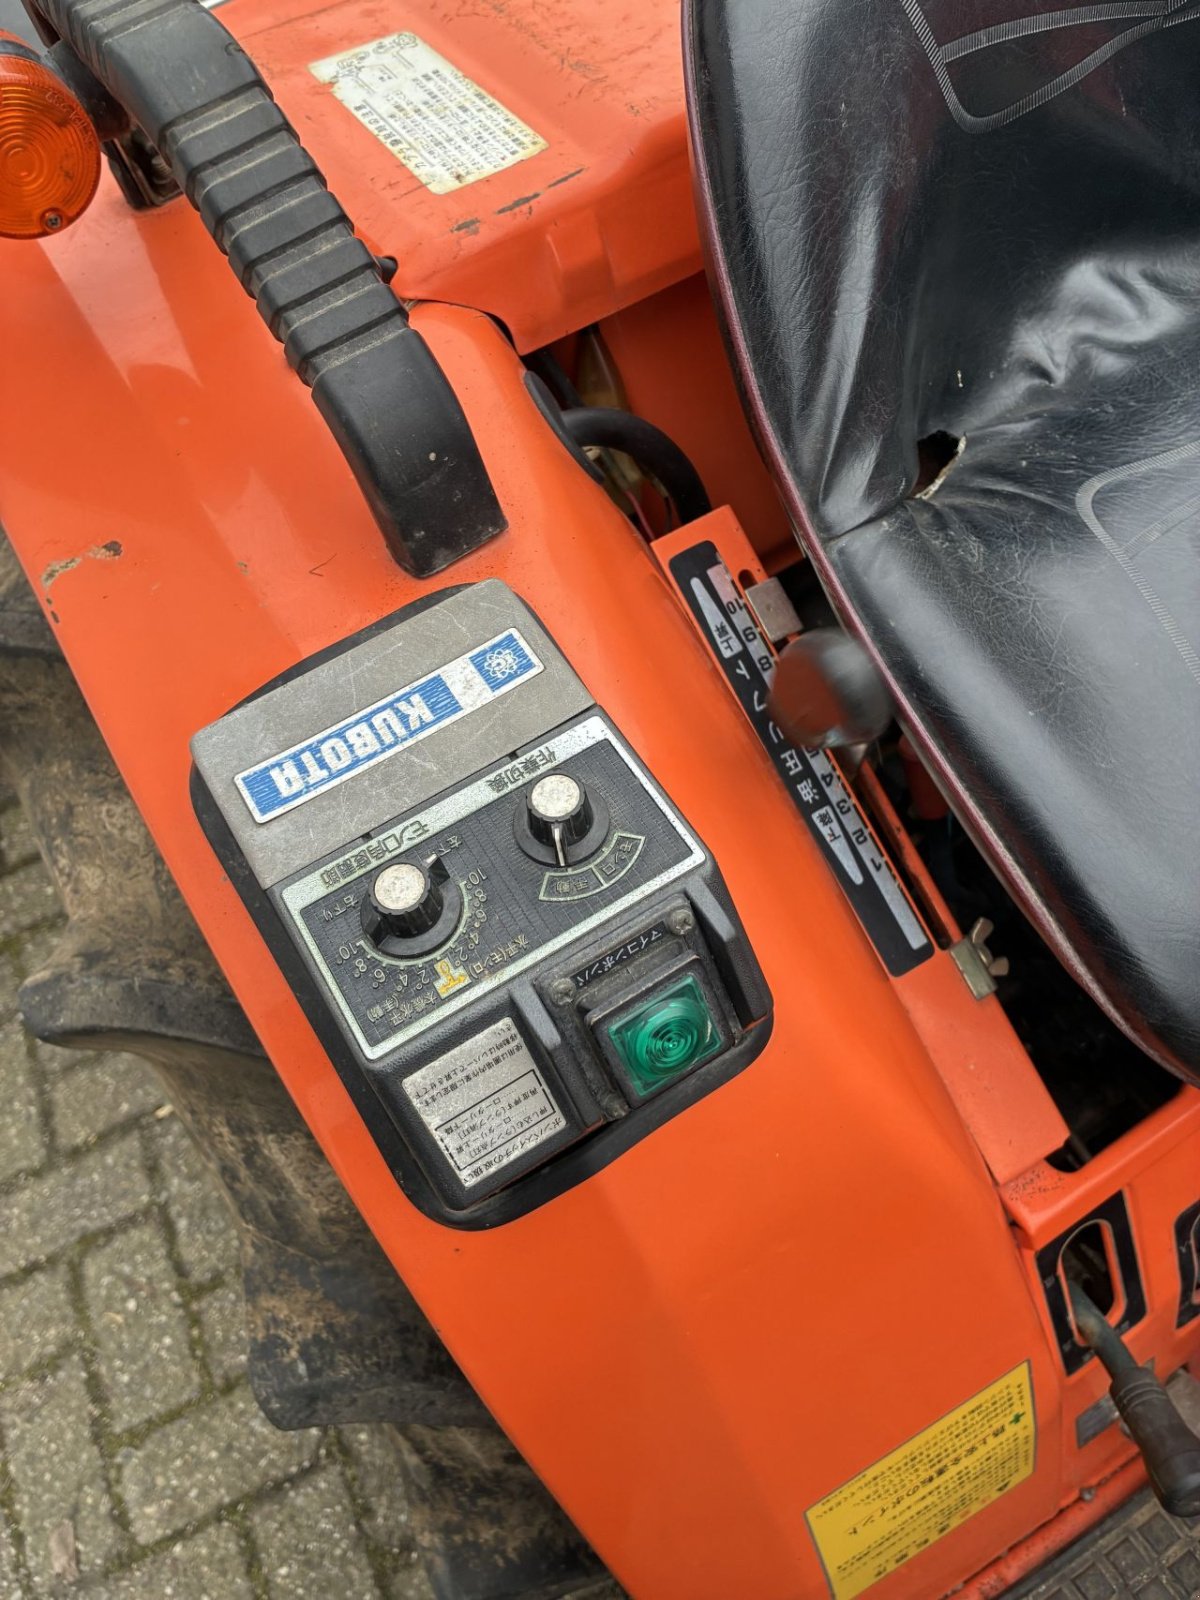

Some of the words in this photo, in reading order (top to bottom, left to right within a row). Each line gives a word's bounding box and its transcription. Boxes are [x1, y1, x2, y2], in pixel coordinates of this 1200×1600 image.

[723, 597, 744, 615] 10
[710, 621, 738, 653] 上昇
[740, 625, 758, 642] 9
[755, 654, 773, 671] 8
[727, 657, 820, 805] 油圧リフト
[266, 690, 435, 801] KUBOTA
[483, 744, 559, 796] 作業切換
[819, 770, 836, 787] 4
[834, 797, 851, 815] 3
[814, 808, 842, 843] 下降
[850, 827, 868, 845] 2
[318, 815, 430, 889] モンロ角度調節
[869, 855, 883, 872] 1
